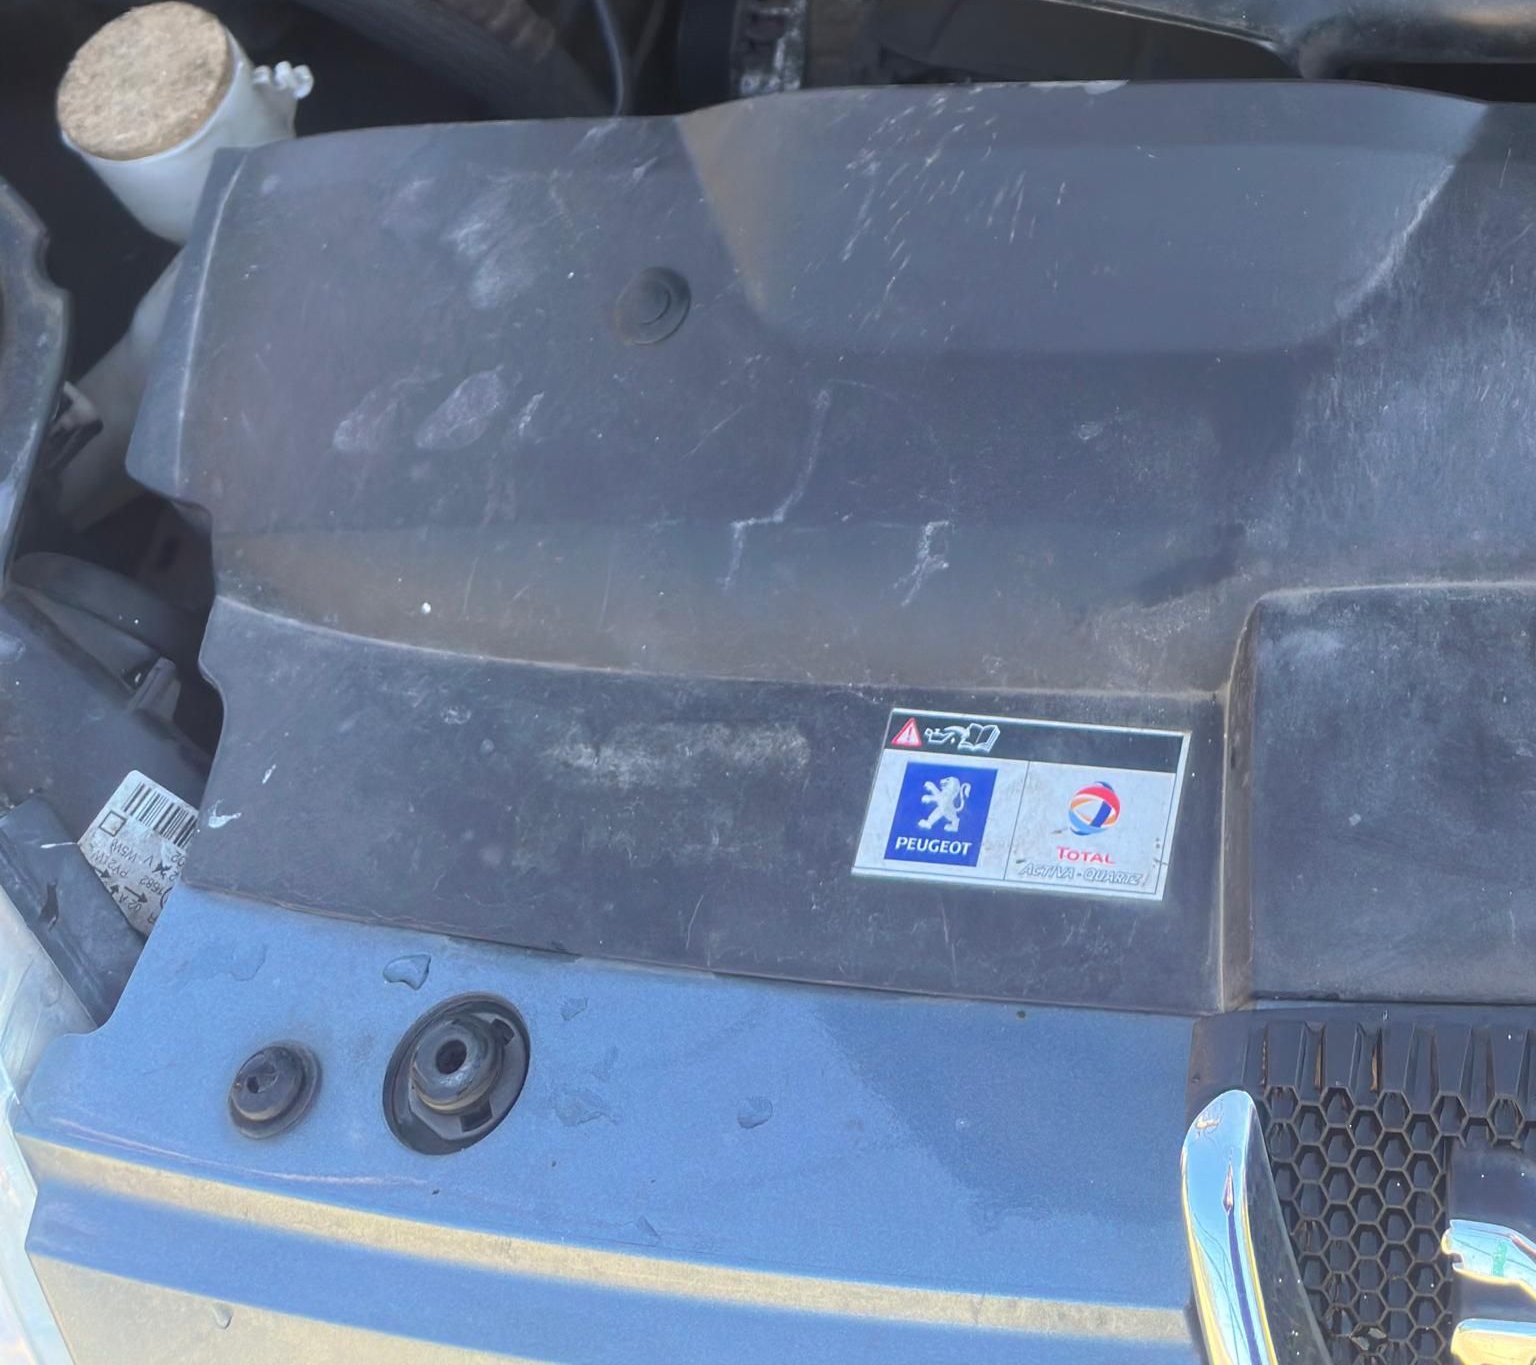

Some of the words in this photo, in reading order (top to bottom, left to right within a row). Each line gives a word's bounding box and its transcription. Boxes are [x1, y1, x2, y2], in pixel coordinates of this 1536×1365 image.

[894, 836, 972, 855] PEUGEOT
[1056, 846, 1115, 864] TOTAL
[1018, 862, 1075, 878] ACTIVA
[1083, 866, 1147, 886] QUARTZ
